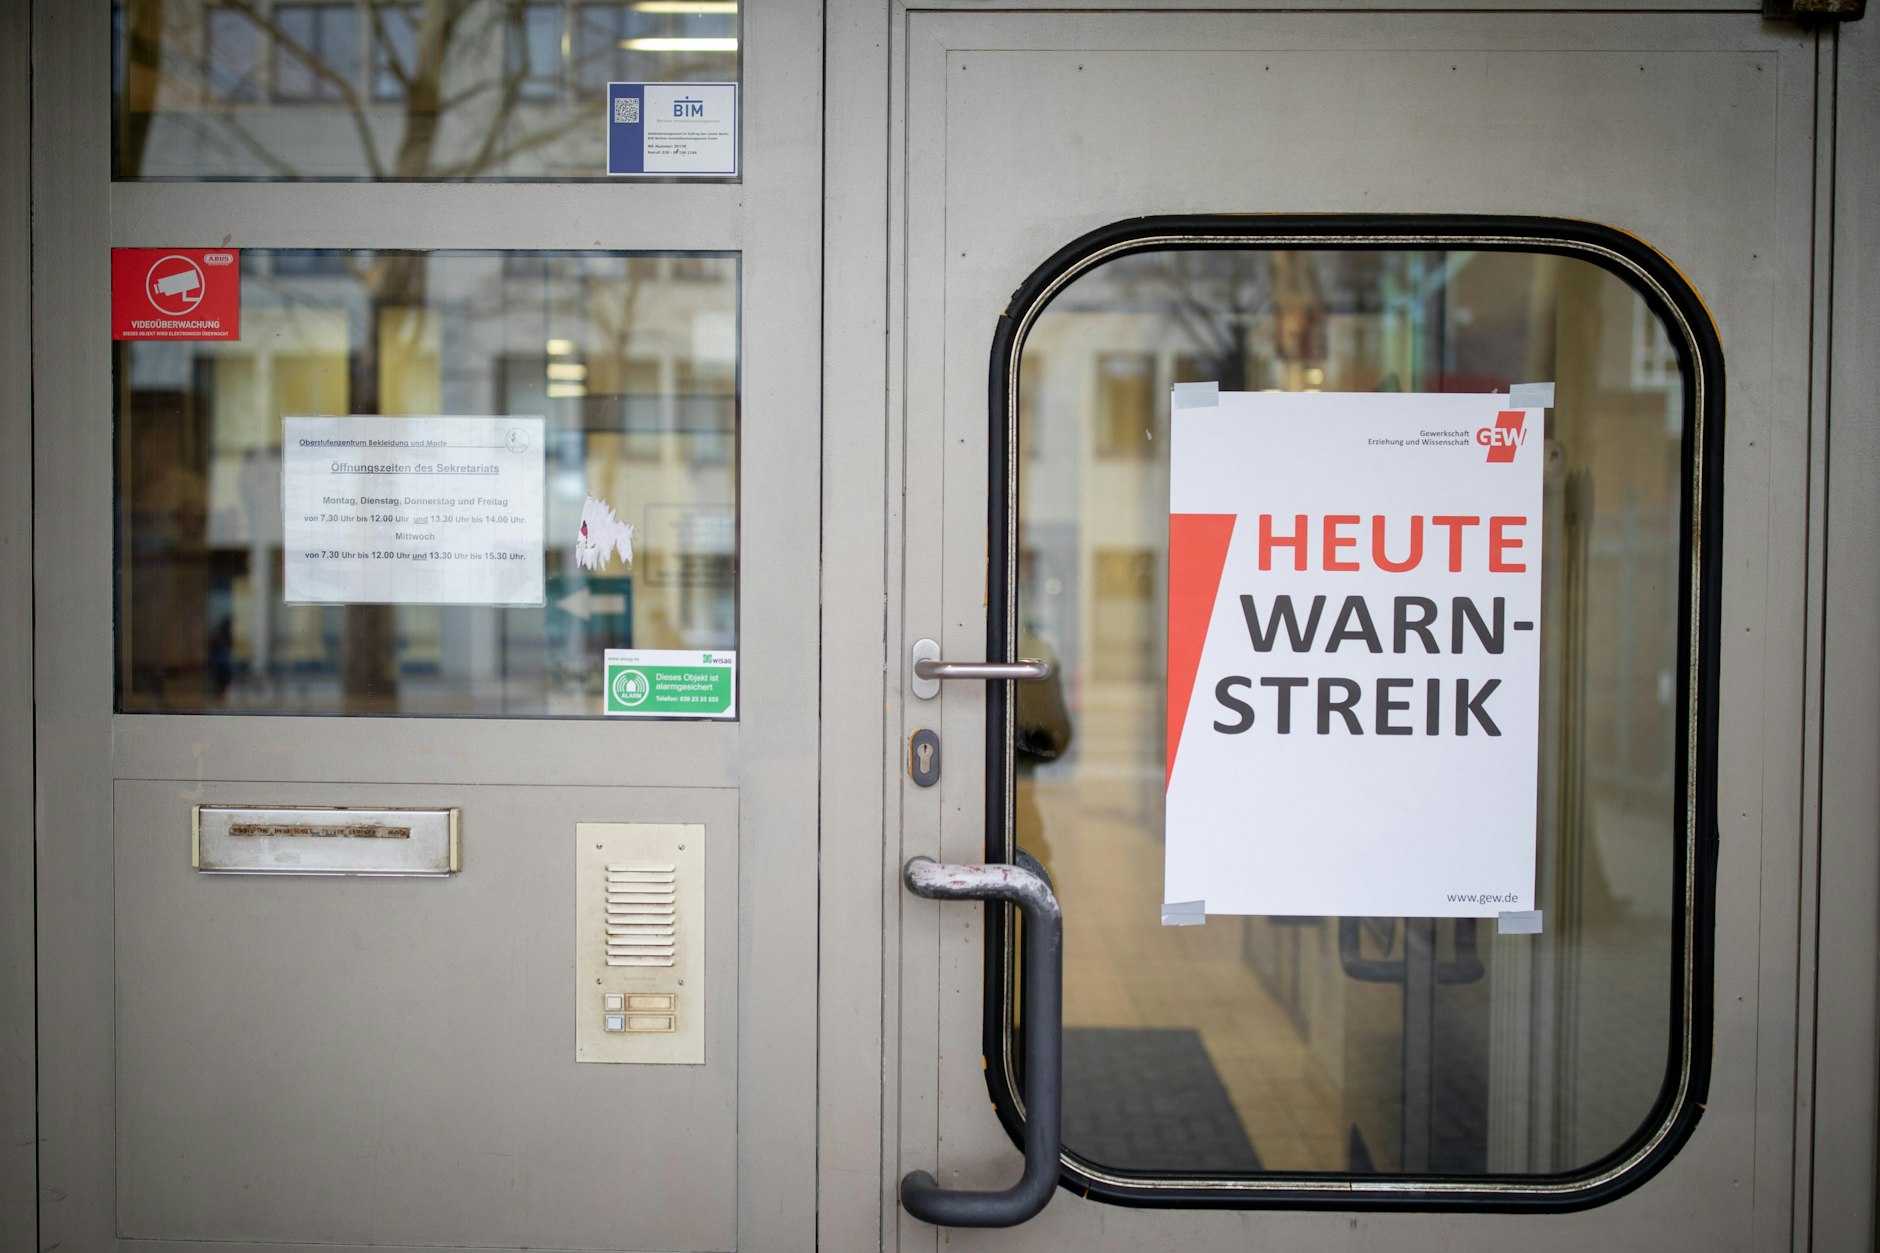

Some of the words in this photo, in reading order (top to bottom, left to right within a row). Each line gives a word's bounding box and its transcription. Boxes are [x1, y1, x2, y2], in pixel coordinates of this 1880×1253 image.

[674, 104, 703, 117] BIM
[131, 319, 220, 328] VIDEOÜBERWACHUNG
[1476, 427, 1525, 446] GEW
[299, 438, 366, 447] Oberstufenzentrum
[368, 438, 408, 448] Bekleidung
[410, 439, 424, 447] und
[426, 439, 447, 447] Mode
[1368, 438, 1404, 446] Erziehung
[331, 461, 411, 474] Öffnungszeiten
[414, 464, 432, 473] des
[436, 463, 500, 474] Sekretariats
[322, 496, 358, 506] Montag,
[360, 496, 402, 506] Dienstag,
[404, 496, 456, 506] Donnerstag
[458, 497, 474, 506] und
[477, 498, 508, 507] Freitag
[320, 514, 338, 522] 7.30
[340, 514, 354, 522] Uhr
[356, 514, 368, 522] bis
[370, 514, 394, 522] 12.00
[395, 514, 409, 522] Uhr
[414, 515, 428, 524] und
[430, 514, 454, 523] 13.30
[456, 515, 469, 523] Uhr
[471, 515, 483, 523] bis
[486, 515, 508, 524] 14.00
[395, 532, 436, 541] Mittwoch
[1258, 514, 1527, 573] HEUTE
[322, 551, 339, 559] 7.30
[341, 551, 356, 559] Uhr
[358, 551, 369, 559] bis
[372, 551, 394, 560] 12.00
[396, 552, 410, 560] Uhr
[412, 552, 427, 561] und
[429, 552, 452, 560] 13.30
[454, 552, 468, 560] Uhr
[470, 552, 482, 560] bis
[484, 552, 508, 560] 15.30
[509, 552, 526, 560] Uhr.
[1239, 594, 1534, 654] WARN-
[656, 673, 682, 681] Dieses
[683, 674, 708, 682] Objekt
[656, 683, 713, 692] alarmgesichert
[1213, 675, 1502, 736] STREIK
[1446, 892, 1518, 904] www.gew.de
